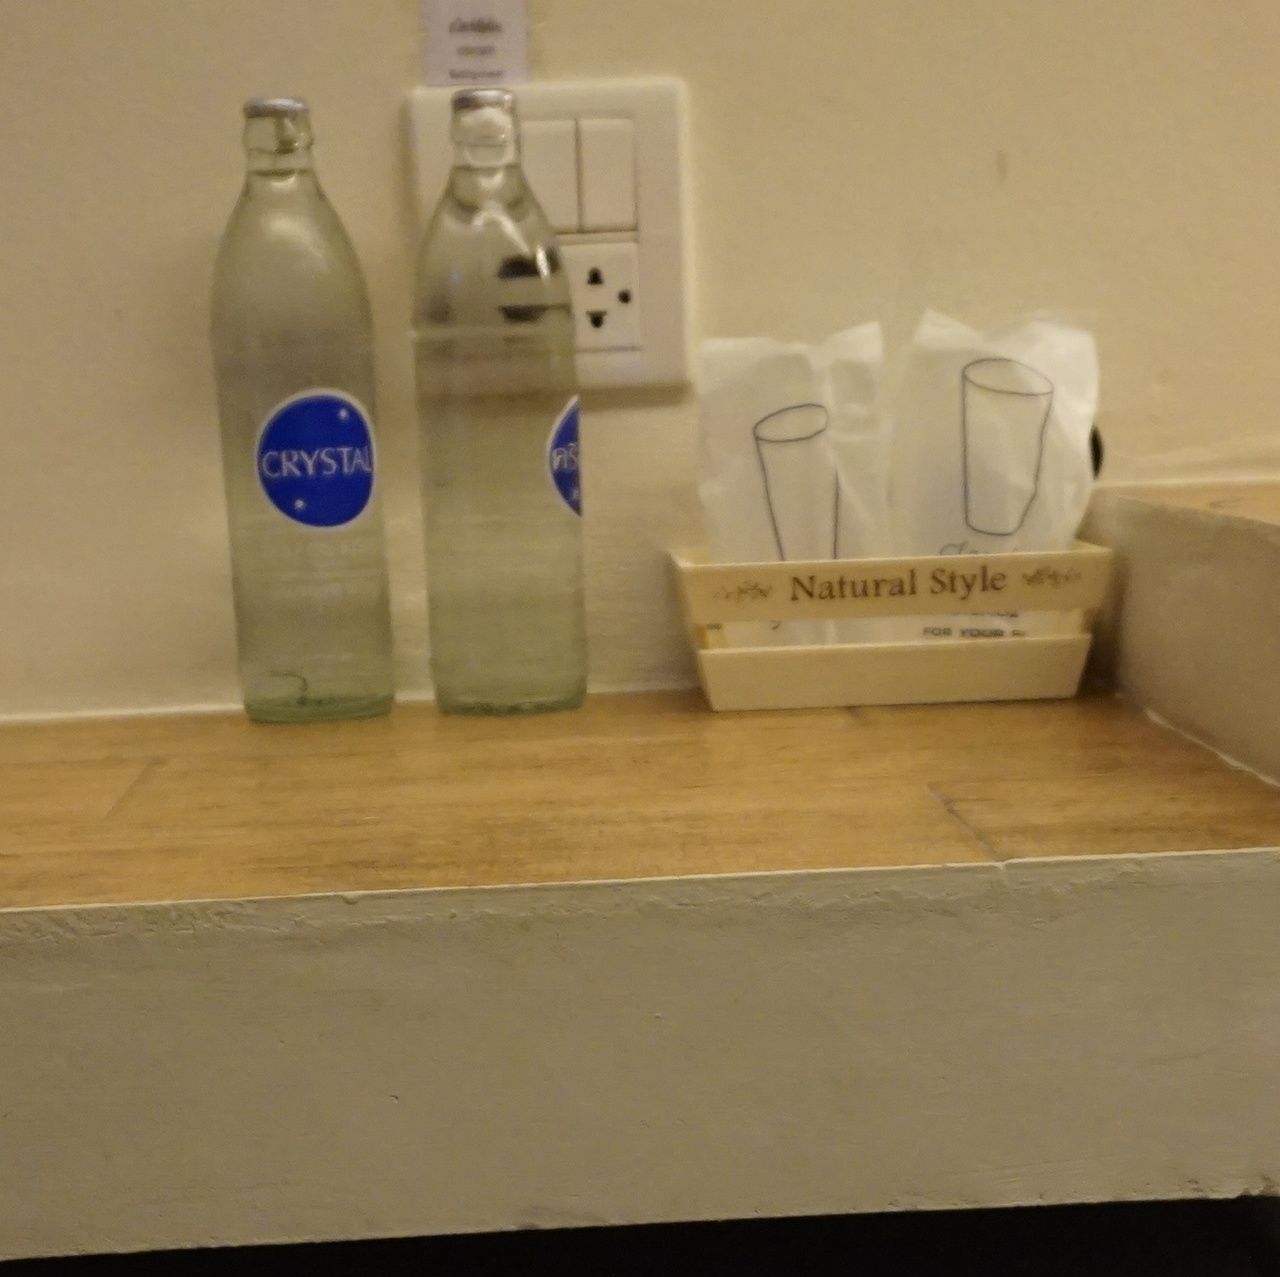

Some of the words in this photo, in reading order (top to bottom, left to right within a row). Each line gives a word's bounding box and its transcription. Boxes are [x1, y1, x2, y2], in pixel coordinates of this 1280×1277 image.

[261, 446, 372, 478] CRYSTAL
[790, 568, 916, 602] Natural
[929, 563, 1007, 601] Style
